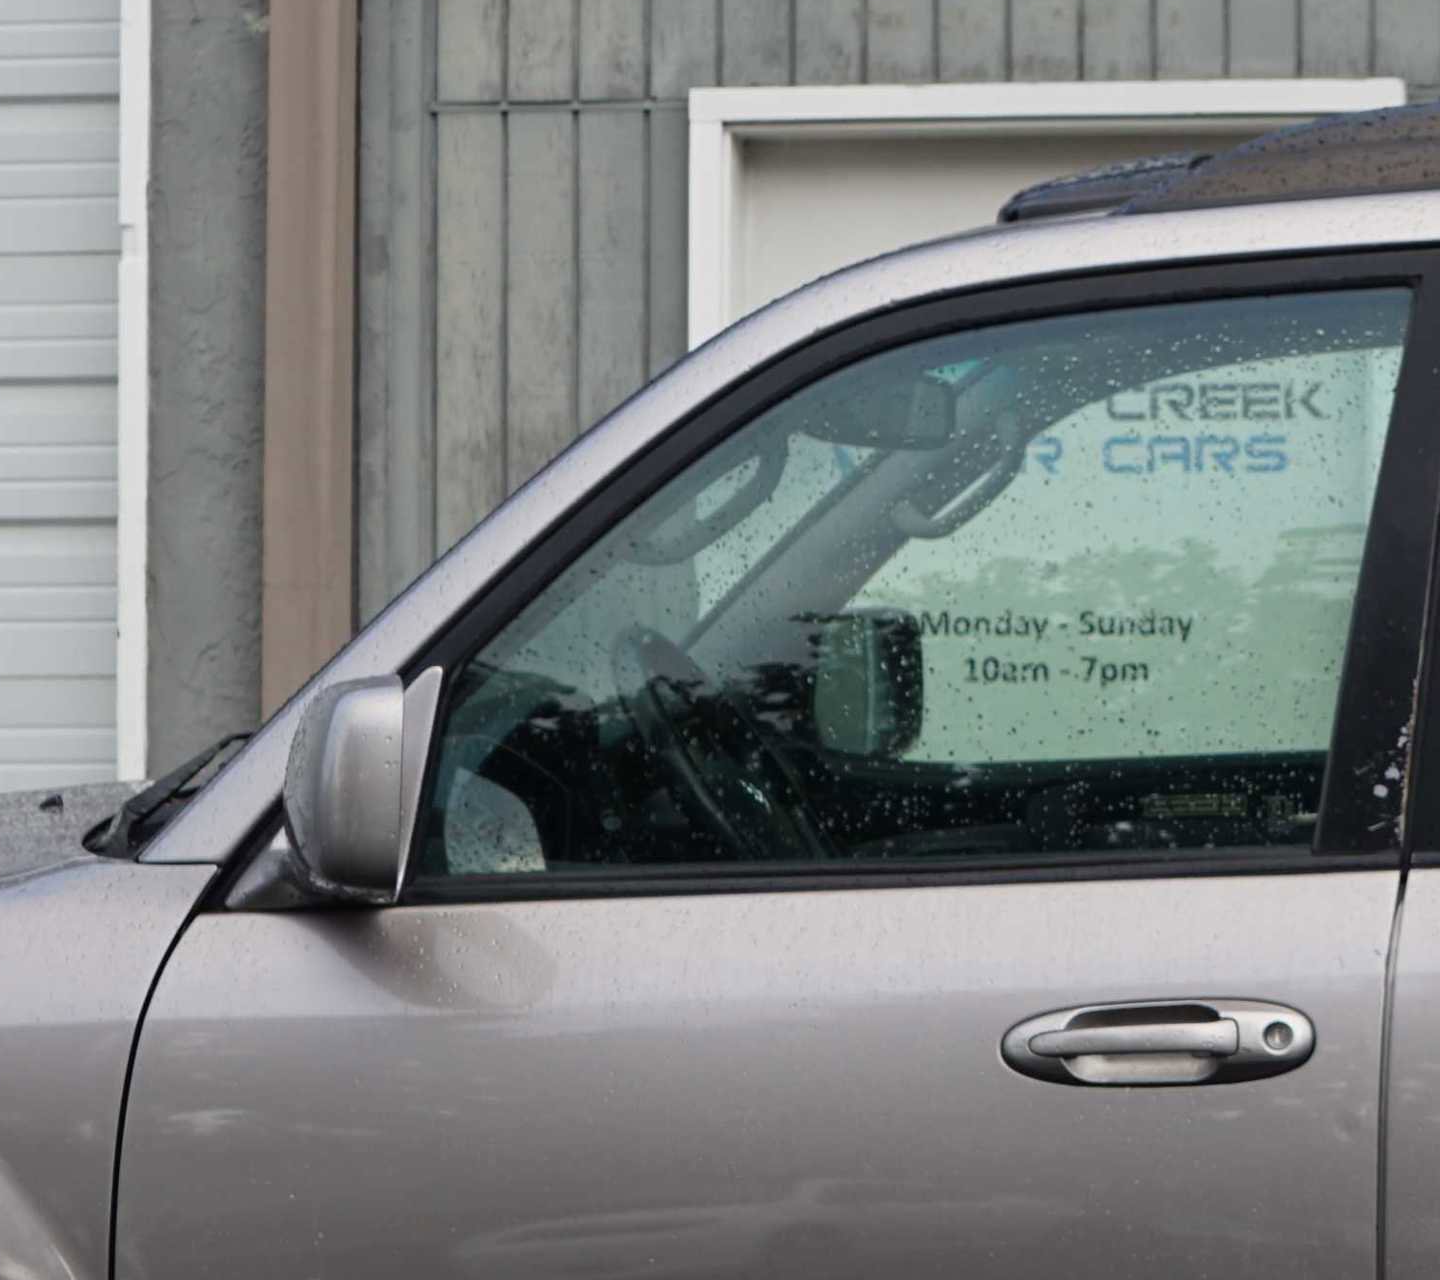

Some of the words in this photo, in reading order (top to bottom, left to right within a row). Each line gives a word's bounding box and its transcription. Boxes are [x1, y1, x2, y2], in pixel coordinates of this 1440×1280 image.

[1105, 380, 1331, 421] CREEK
[1102, 433, 1289, 474] CARS
[919, 610, 1049, 642] Monday
[1078, 609, 1194, 642] Sunday
[963, 656, 1050, 683] 10am
[1079, 656, 1150, 688] 7pm
